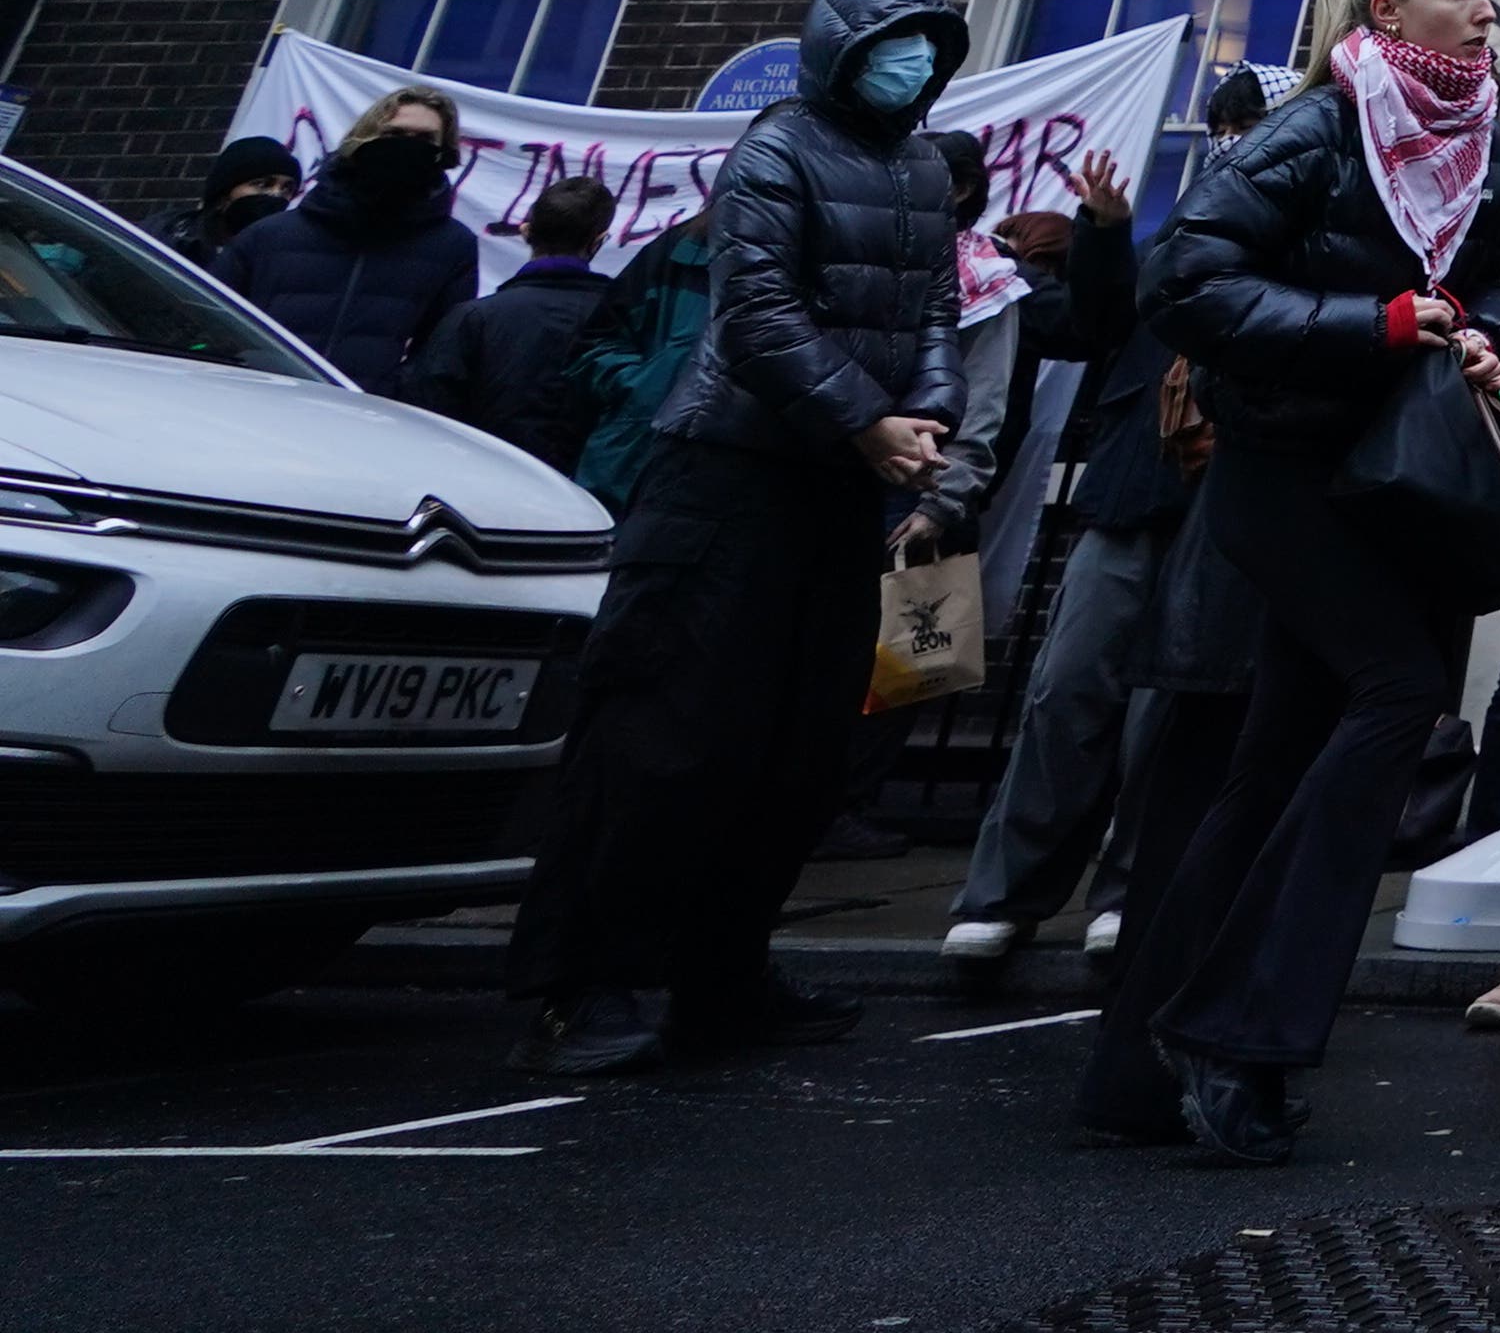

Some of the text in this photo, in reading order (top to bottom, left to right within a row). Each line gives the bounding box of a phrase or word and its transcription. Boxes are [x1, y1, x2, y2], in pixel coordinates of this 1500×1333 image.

[763, 63, 789, 77] SIR
[732, 79, 798, 93] RICHAR
[912, 632, 952, 654] LEON
[310, 663, 514, 719] WV19 PKC
